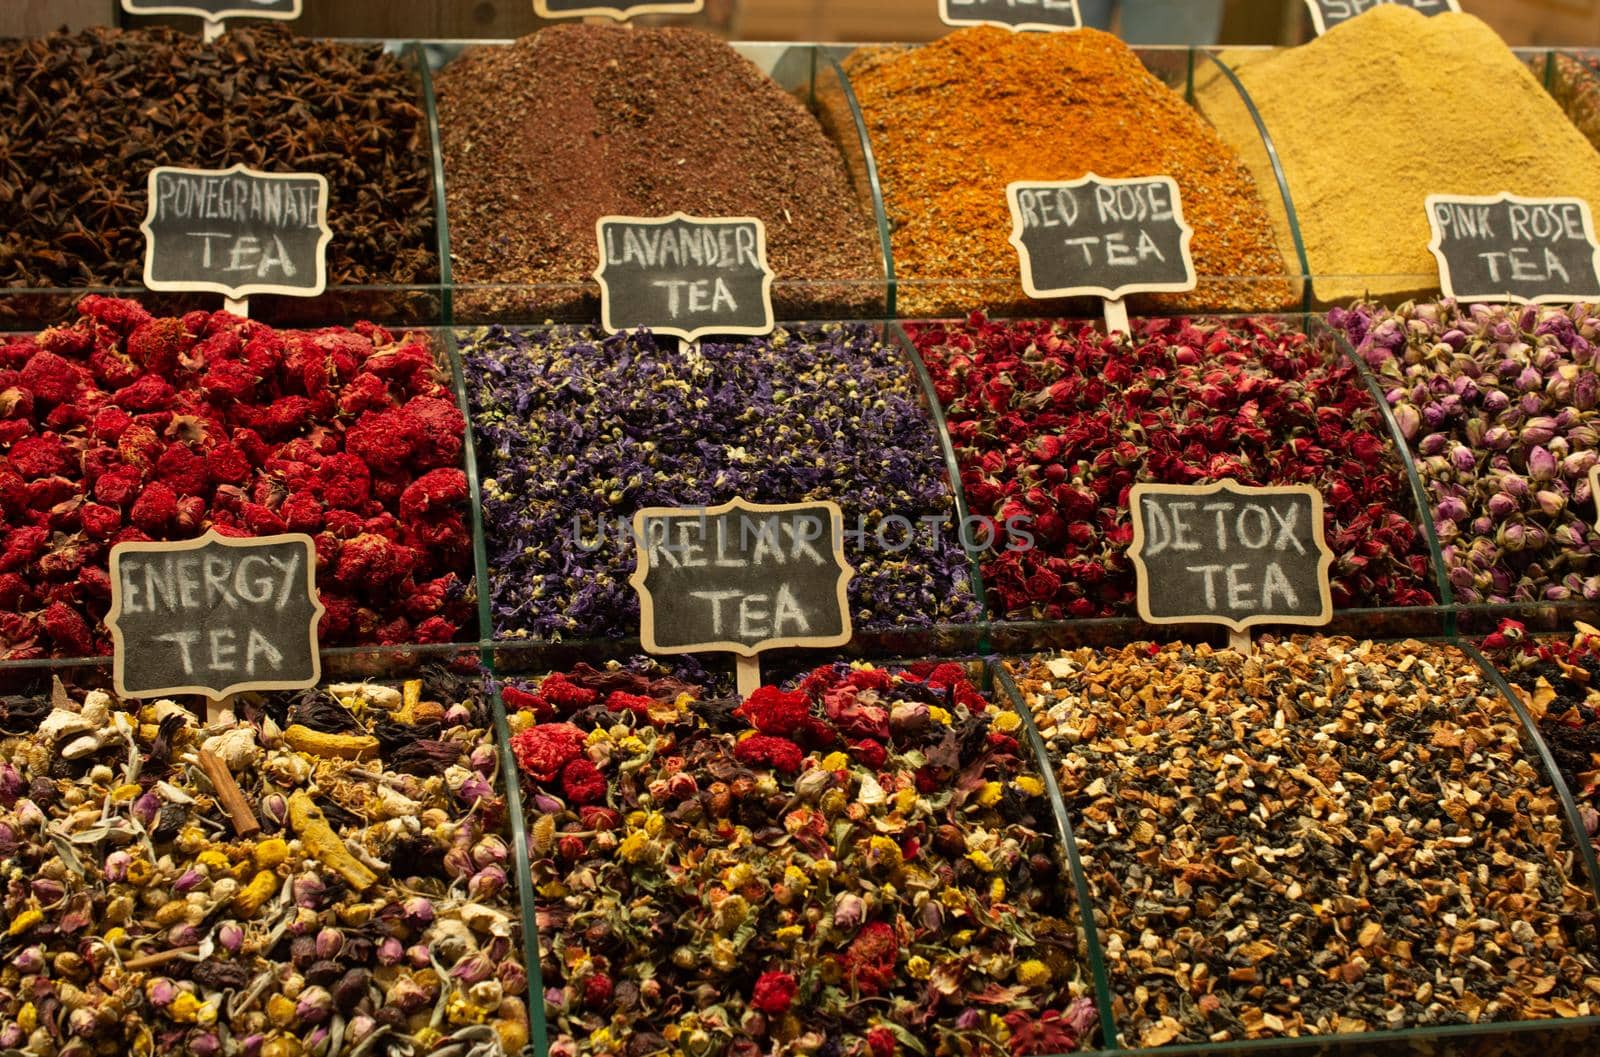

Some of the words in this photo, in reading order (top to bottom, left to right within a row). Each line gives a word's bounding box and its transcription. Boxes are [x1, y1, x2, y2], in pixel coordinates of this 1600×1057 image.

[1019, 188, 1079, 228] RED
[1095, 183, 1173, 224] ROSE
[1435, 204, 1495, 240] PINK
[1509, 204, 1585, 242] ROSE
[186, 232, 297, 278] TEA
[606, 226, 760, 270] LAVANDER
[1065, 229, 1166, 266] TEA
[1477, 247, 1570, 284] TEA
[653, 277, 738, 319] TEA
[649, 519, 827, 568] RELAX
[1142, 498, 1306, 557] DETOX
[120, 551, 300, 614] ENERGY
[1186, 562, 1299, 610] TEA
[689, 583, 811, 637] TEA
[151, 628, 283, 676] TEA
